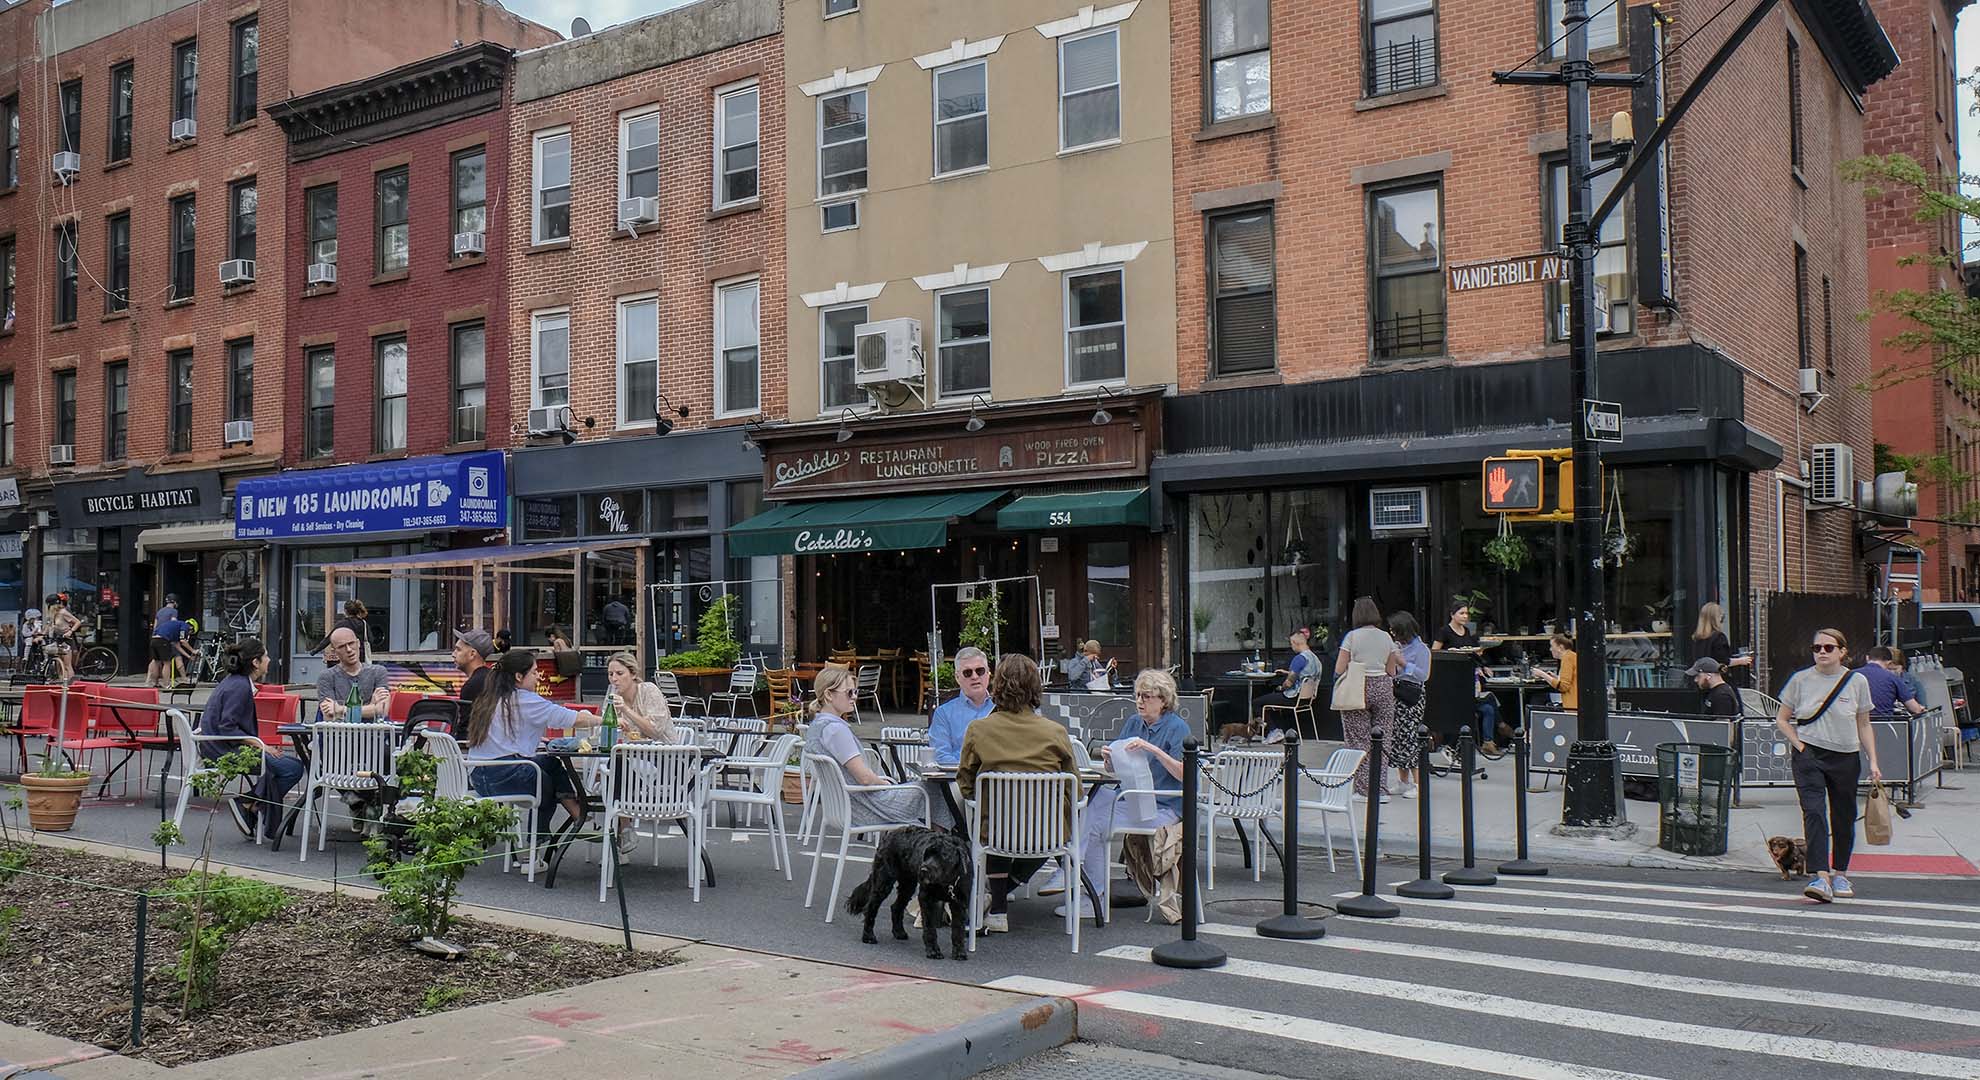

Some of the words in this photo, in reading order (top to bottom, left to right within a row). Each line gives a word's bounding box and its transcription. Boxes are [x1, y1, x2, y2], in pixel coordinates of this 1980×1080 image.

[1452, 260, 1536, 290] VANDERBILT
[1541, 257, 1559, 280] AV
[1025, 441, 1051, 451] WOOD
[1055, 439, 1078, 449] FIRED
[1083, 436, 1104, 446] OVEN
[860, 446, 943, 465] RESTAURANT
[1036, 449, 1089, 466] PIZZA
[775, 450, 850, 481] Cataldo's
[877, 458, 978, 478] LUNCHEONETTE
[87, 495, 135, 513] BICYCLE
[140, 489, 193, 508] HABITAT
[258, 496, 288, 518] NEW
[293, 493, 318, 515] 185
[324, 483, 422, 513] LAUNDROMAT
[459, 497, 497, 510] LAUNDROMAT
[459, 511, 497, 523] 347-365-6653
[1049, 511, 1072, 526] 554
[795, 529, 873, 552] Cataldo's
